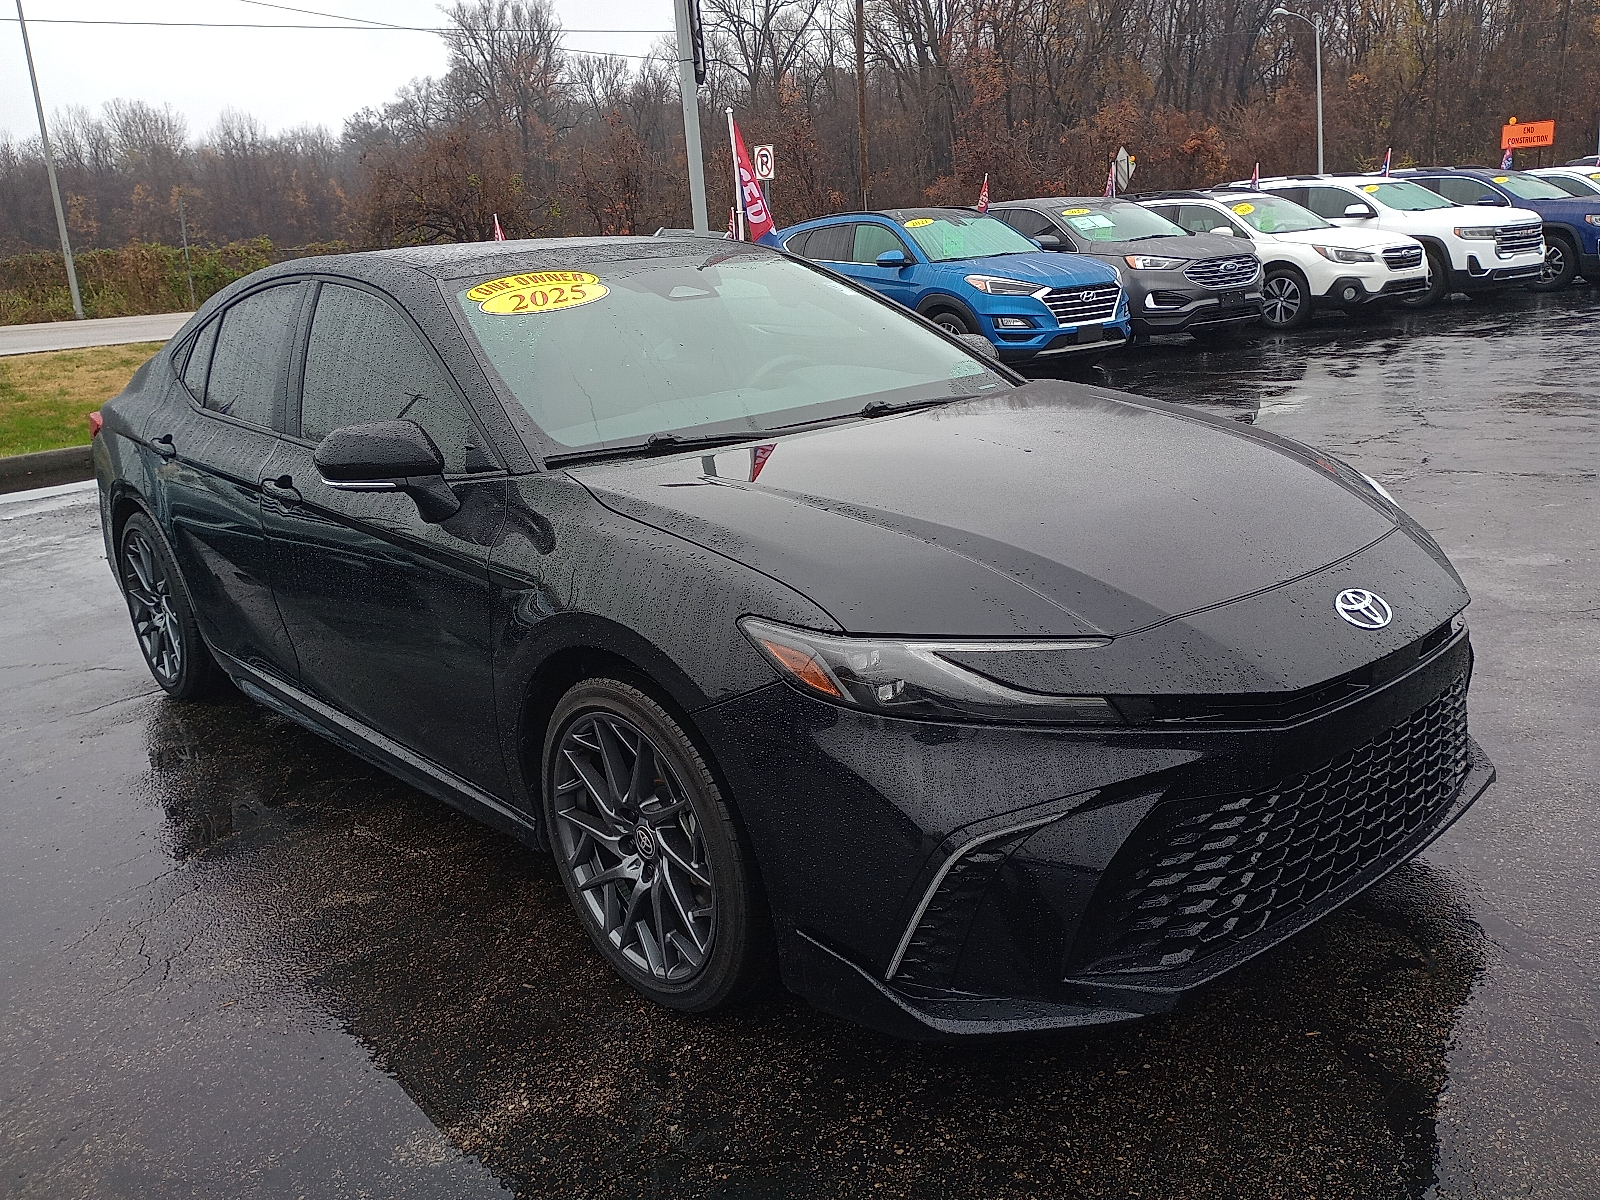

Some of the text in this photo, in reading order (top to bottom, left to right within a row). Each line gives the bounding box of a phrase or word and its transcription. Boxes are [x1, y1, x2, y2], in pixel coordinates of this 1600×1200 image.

[1507, 134, 1549, 145] CONSTRUCTION
[1523, 126, 1535, 134] END
[760, 153, 769, 172] P
[474, 272, 585, 296] ONE OWNER
[508, 283, 587, 311] 2025
